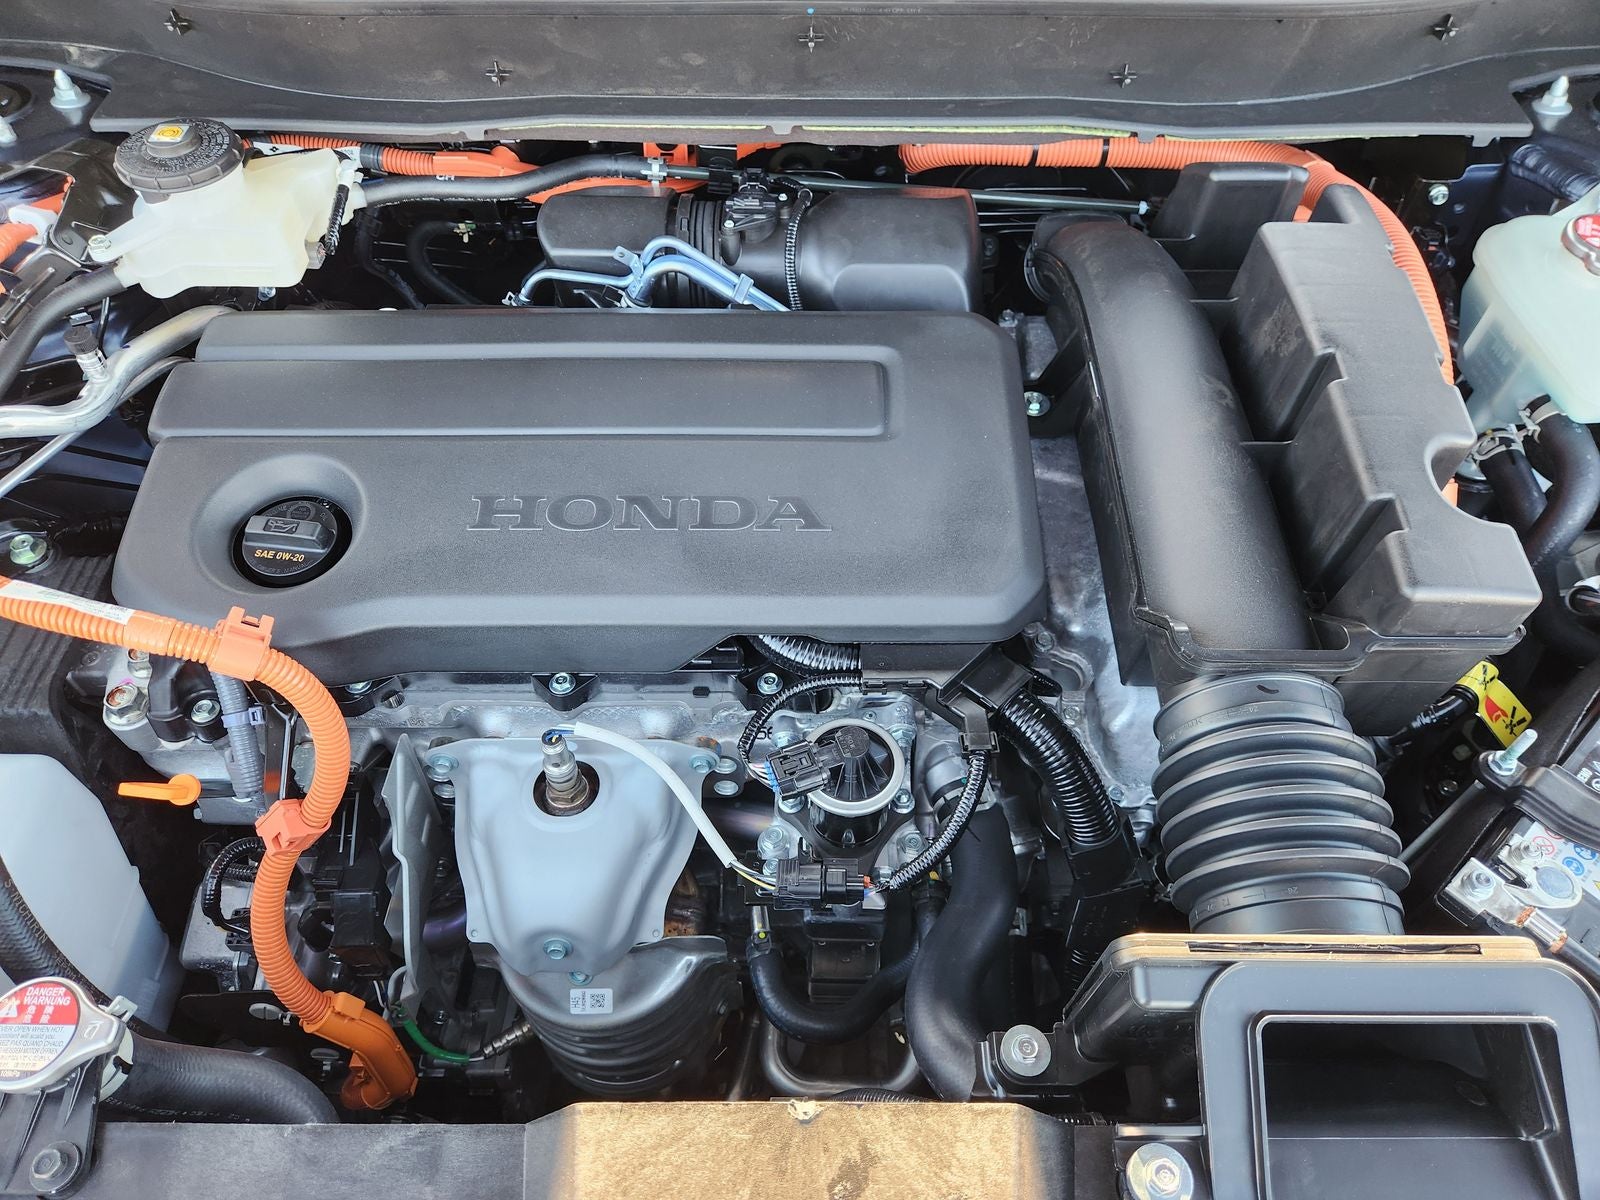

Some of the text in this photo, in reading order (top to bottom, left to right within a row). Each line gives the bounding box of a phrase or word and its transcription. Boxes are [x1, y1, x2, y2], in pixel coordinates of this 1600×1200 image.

[466, 494, 832, 531] HONDA
[254, 549, 305, 562] SAE 0W-20
[26, 986, 66, 996] DANGER
[23, 996, 71, 1006] WARNUNG
